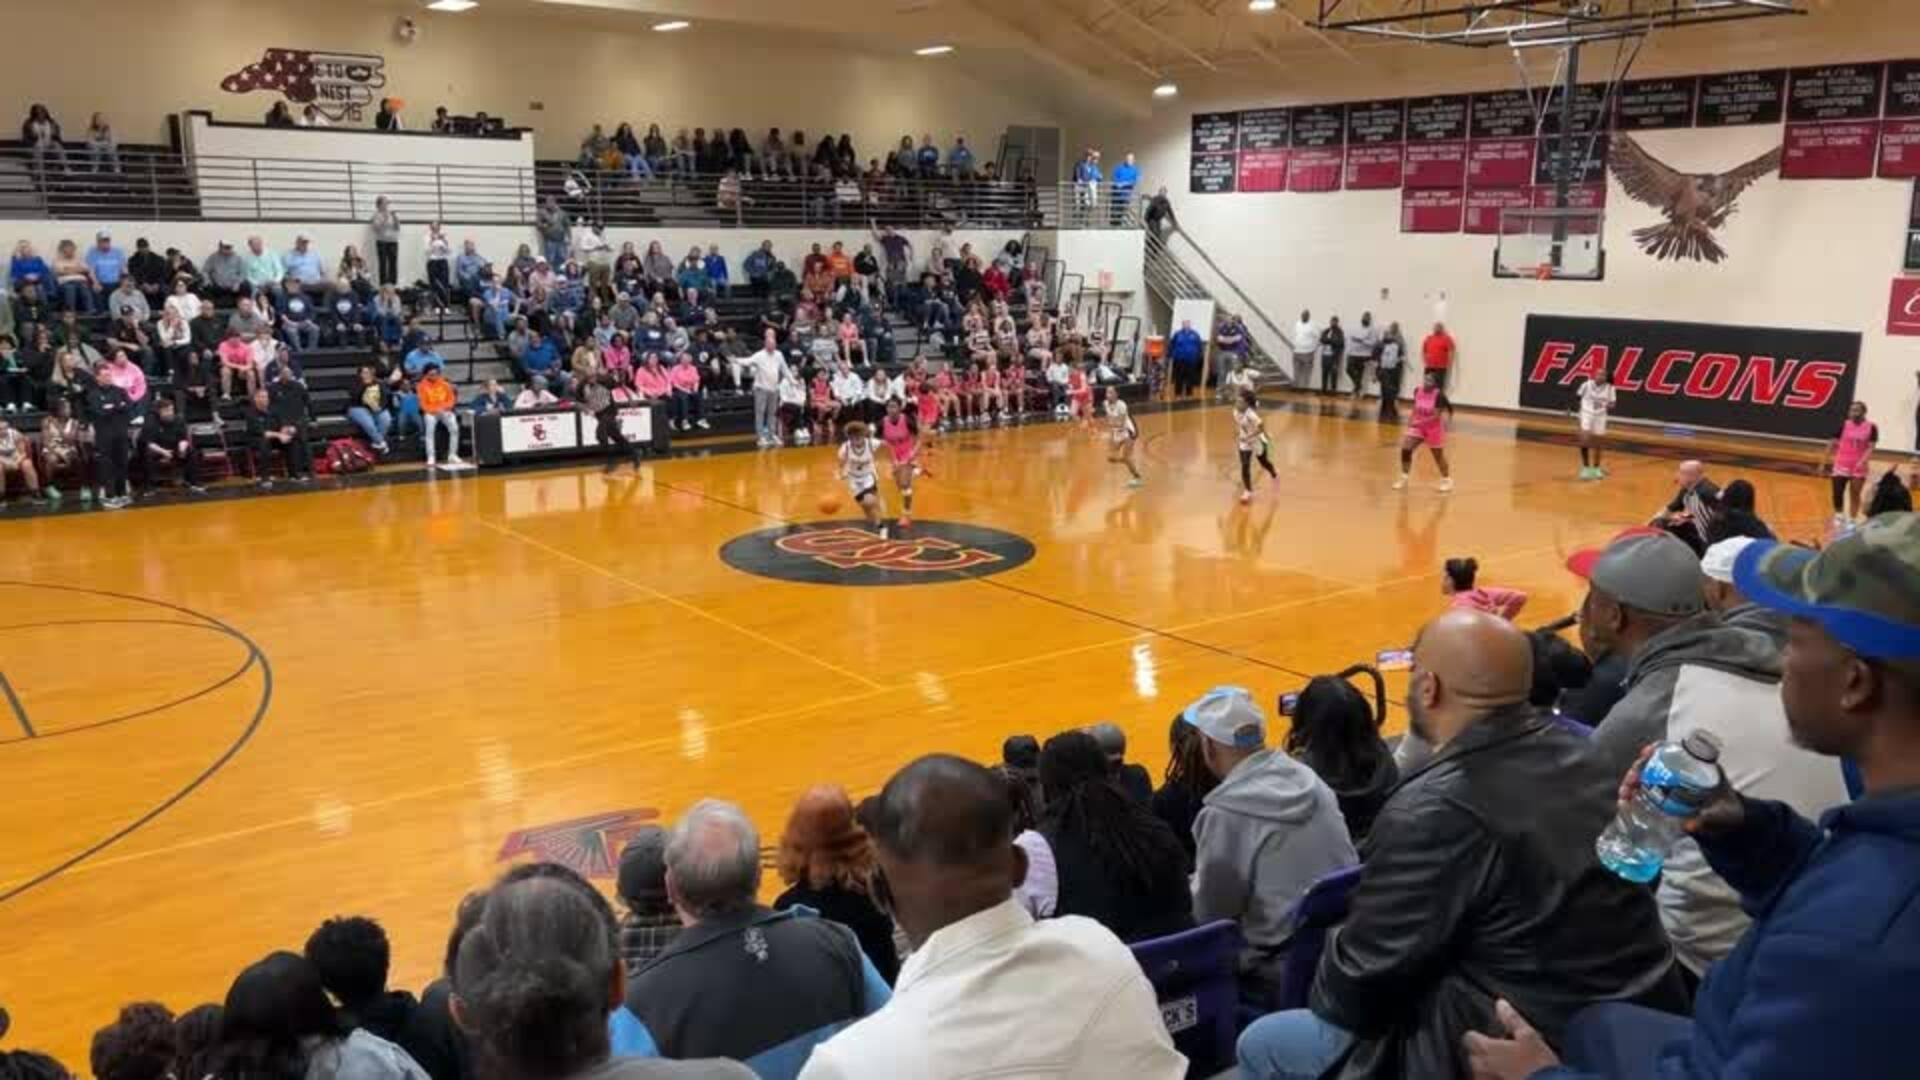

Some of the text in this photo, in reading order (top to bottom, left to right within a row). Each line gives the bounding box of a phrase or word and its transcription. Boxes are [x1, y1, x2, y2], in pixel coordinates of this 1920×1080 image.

[319, 83, 352, 100] NEST
[1529, 341, 1846, 409] FALCONS
[1162, 1003, 1195, 1026] CK'S
